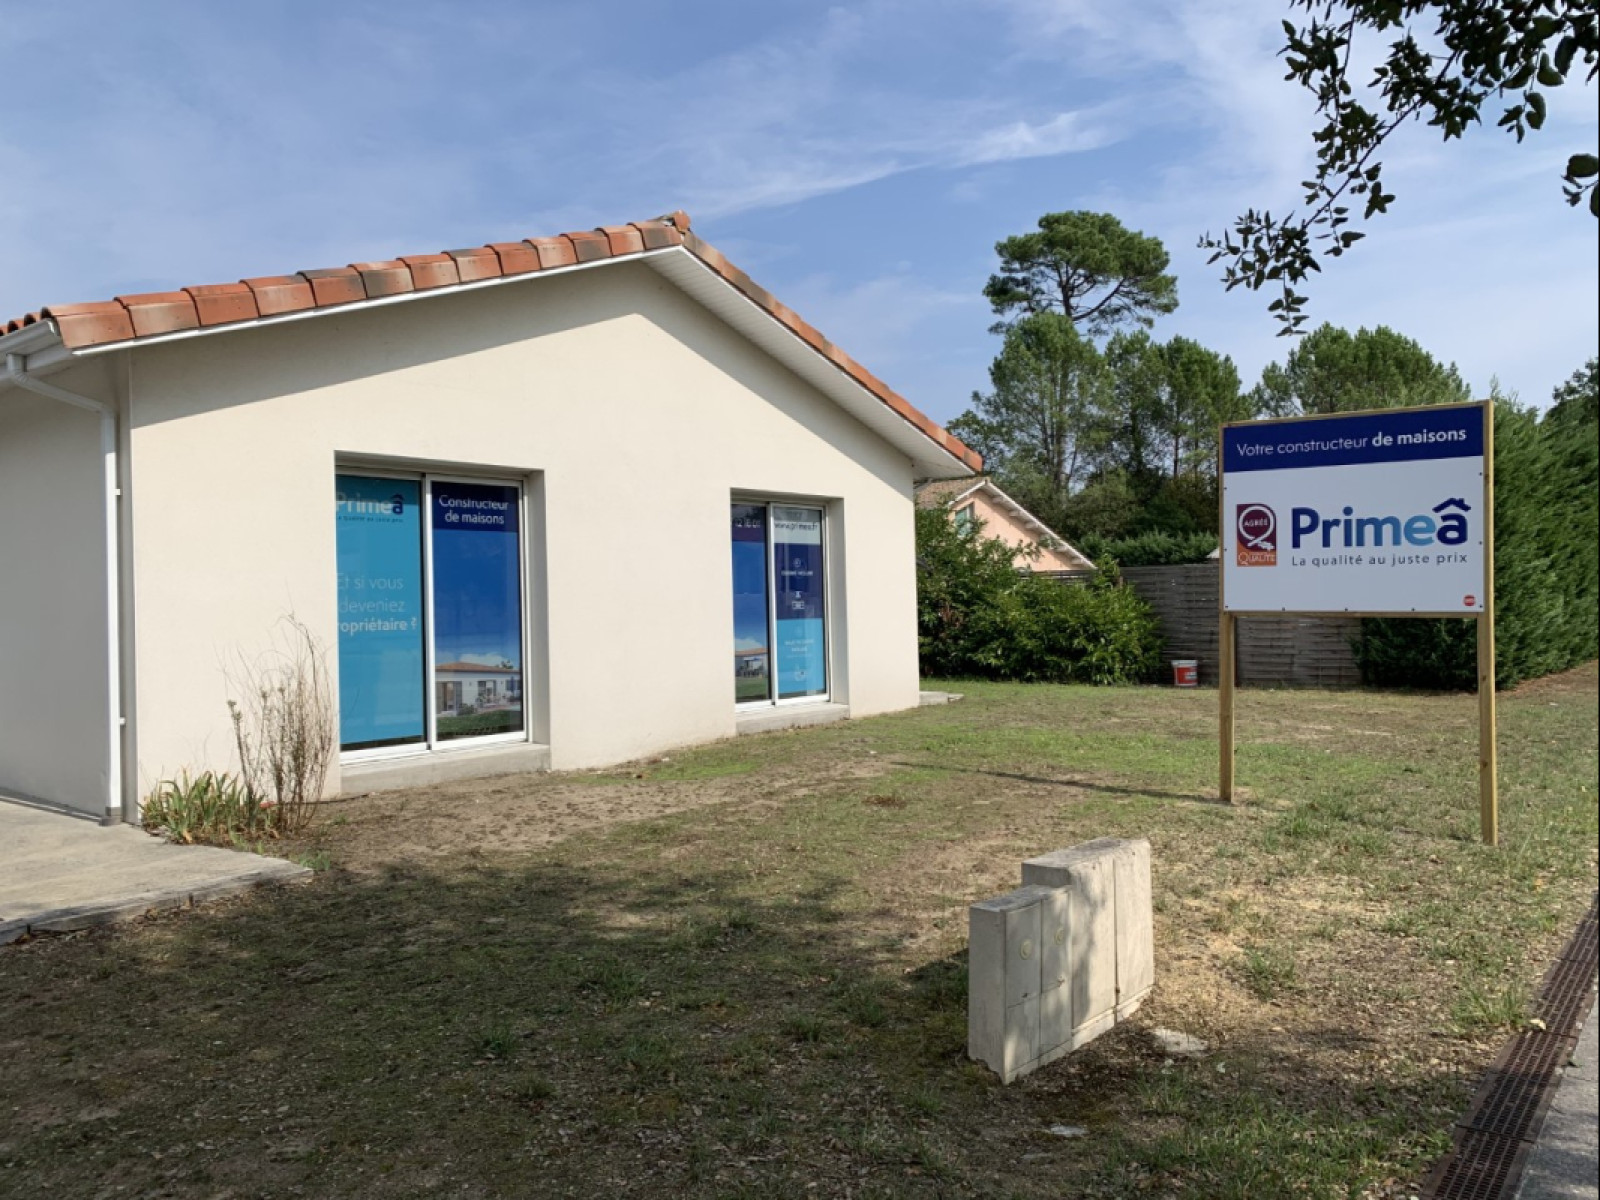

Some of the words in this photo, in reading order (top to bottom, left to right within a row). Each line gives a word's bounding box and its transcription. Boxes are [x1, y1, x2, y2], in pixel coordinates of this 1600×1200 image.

[1236, 443, 1274, 456] Votre
[1277, 438, 1368, 454] constructeur
[1372, 431, 1393, 447] de
[1397, 428, 1467, 445] maisons
[439, 494, 509, 510] Constructeur
[444, 509, 460, 522] de
[461, 512, 505, 525] maisons
[1291, 555, 1306, 566] La
[1311, 554, 1363, 567] qualité
[1368, 555, 1386, 565] au
[1391, 553, 1430, 567] juste
[1437, 552, 1468, 565] prix
[354, 576, 365, 589] si
[369, 578, 404, 590] vous
[339, 596, 406, 613] deveniez
